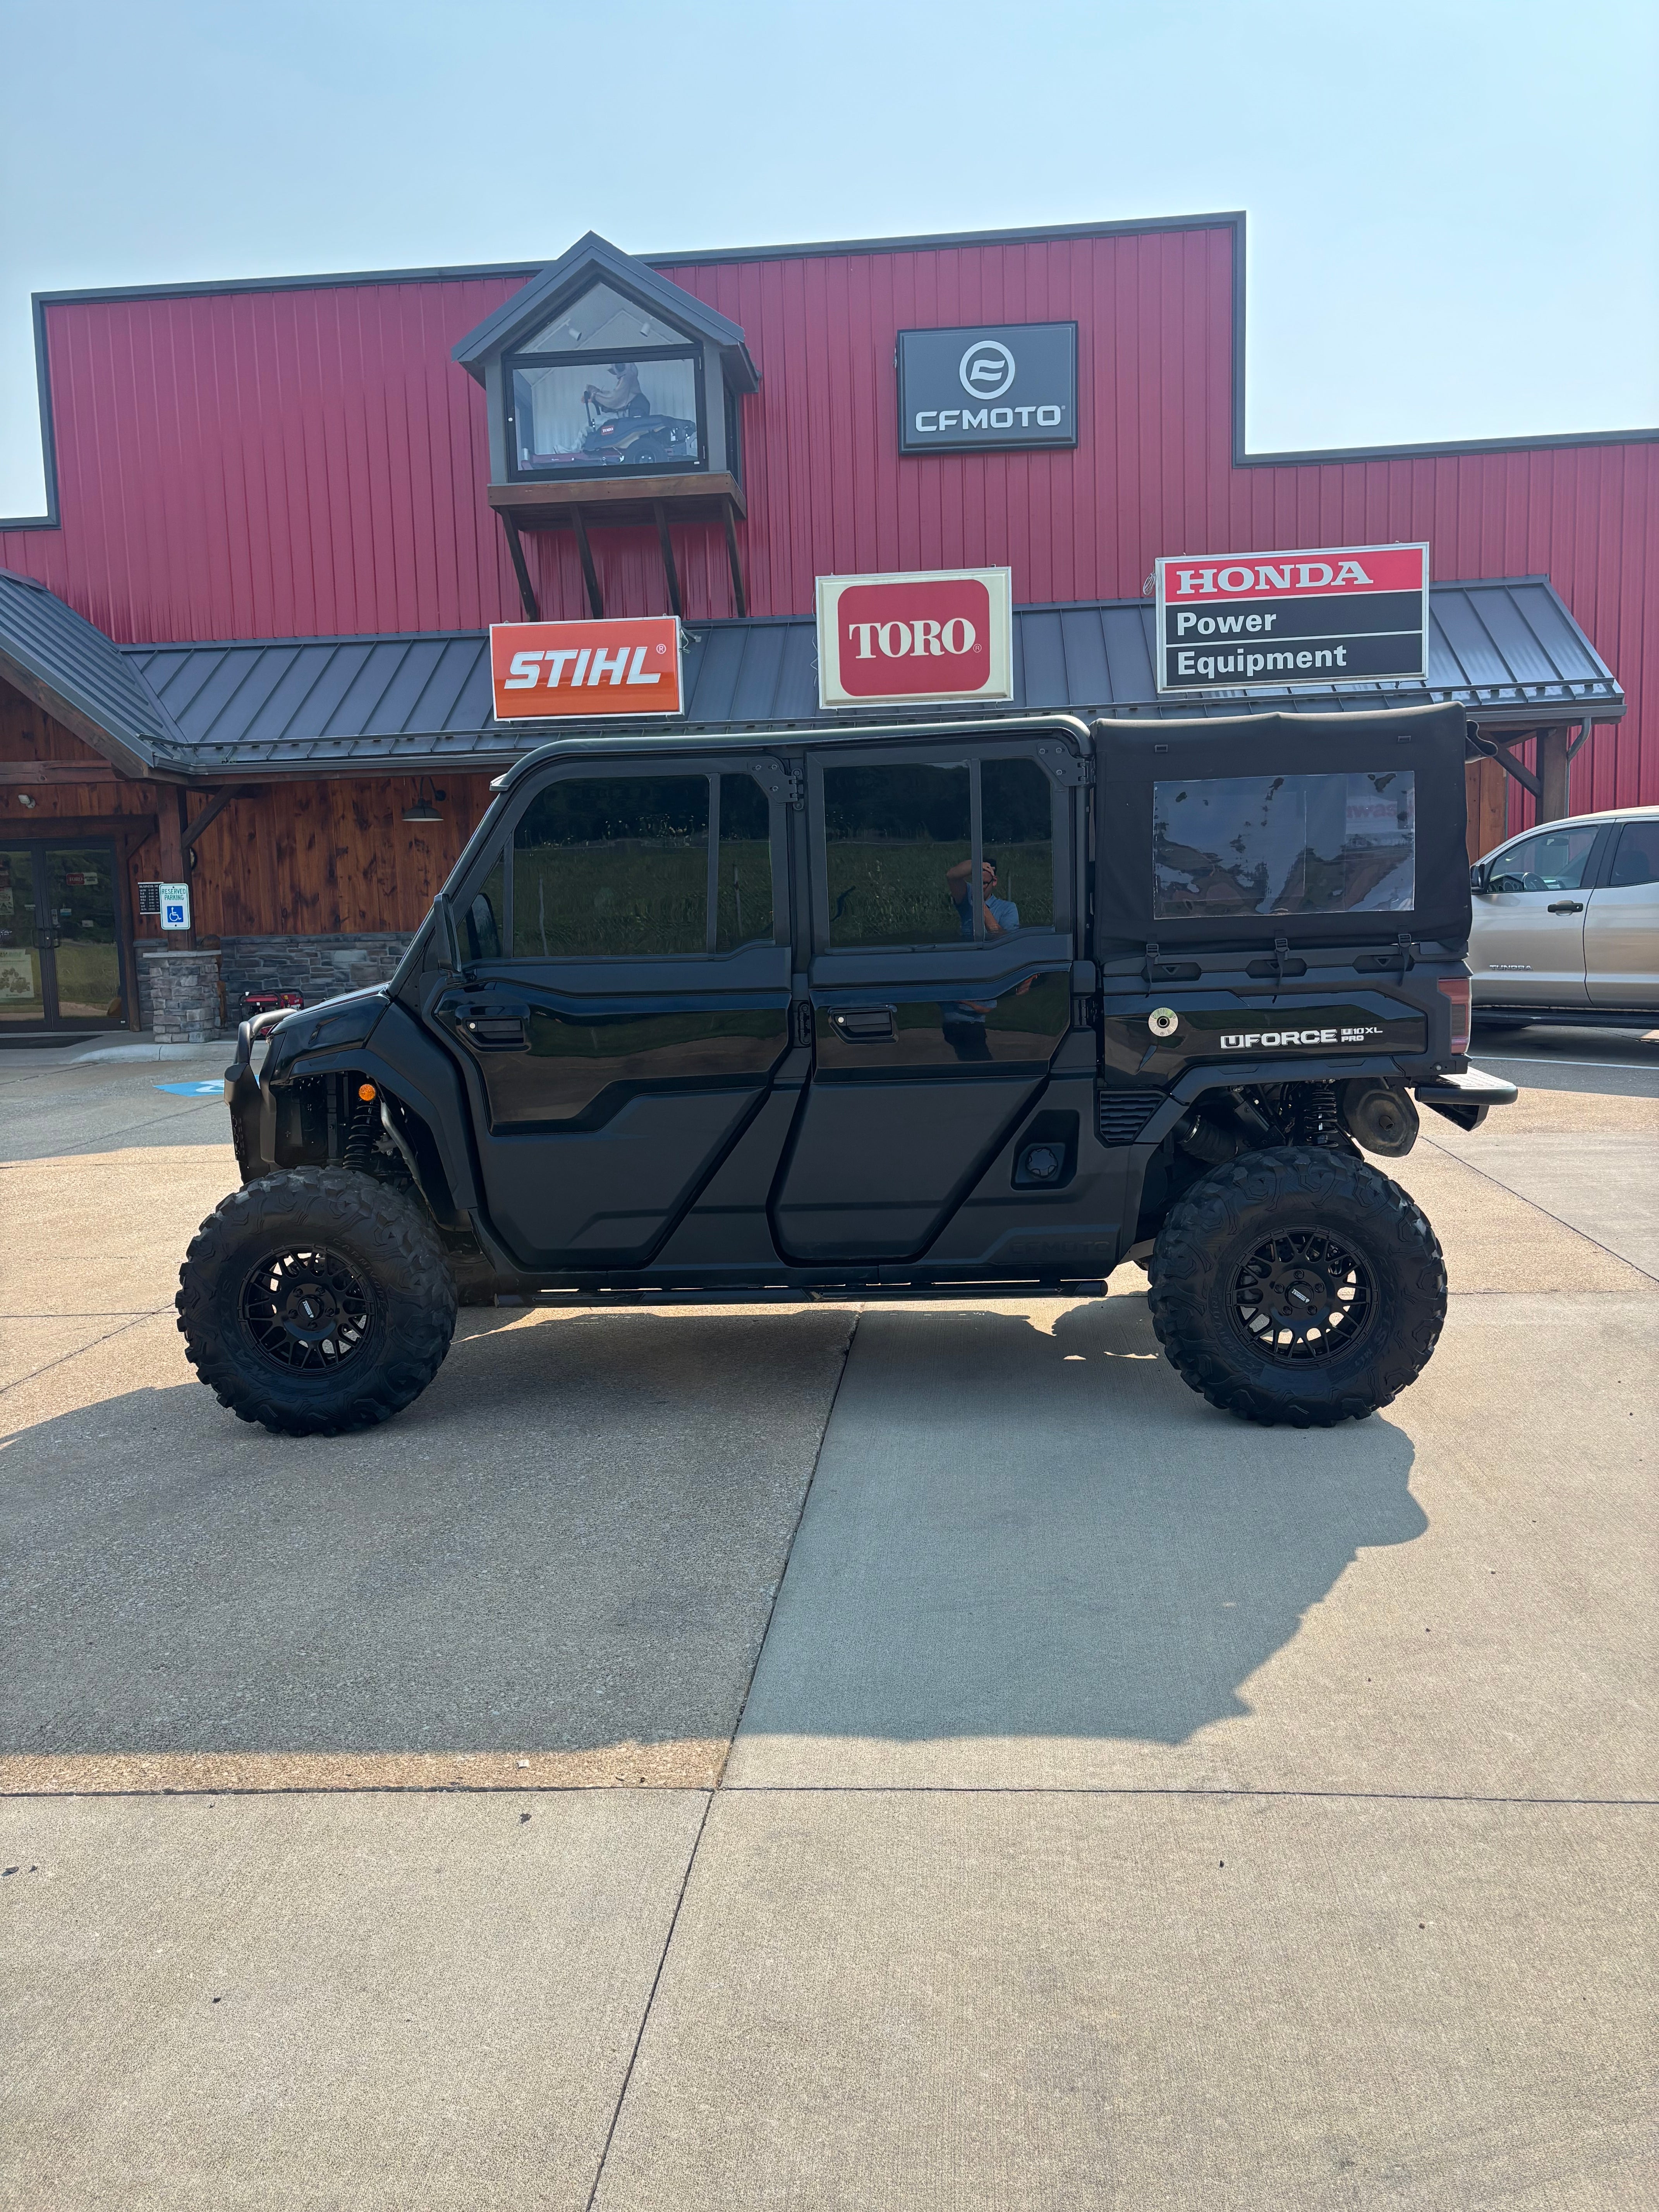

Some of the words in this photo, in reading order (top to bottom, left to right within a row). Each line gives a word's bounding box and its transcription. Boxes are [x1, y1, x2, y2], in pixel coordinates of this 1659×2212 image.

[915, 405, 1061, 432] CFMOTO
[1176, 561, 1374, 594] HONDA
[1177, 612, 1277, 635] Power
[1178, 645, 1347, 678] Equipment
[1221, 1029, 1338, 1049] UFORCE
